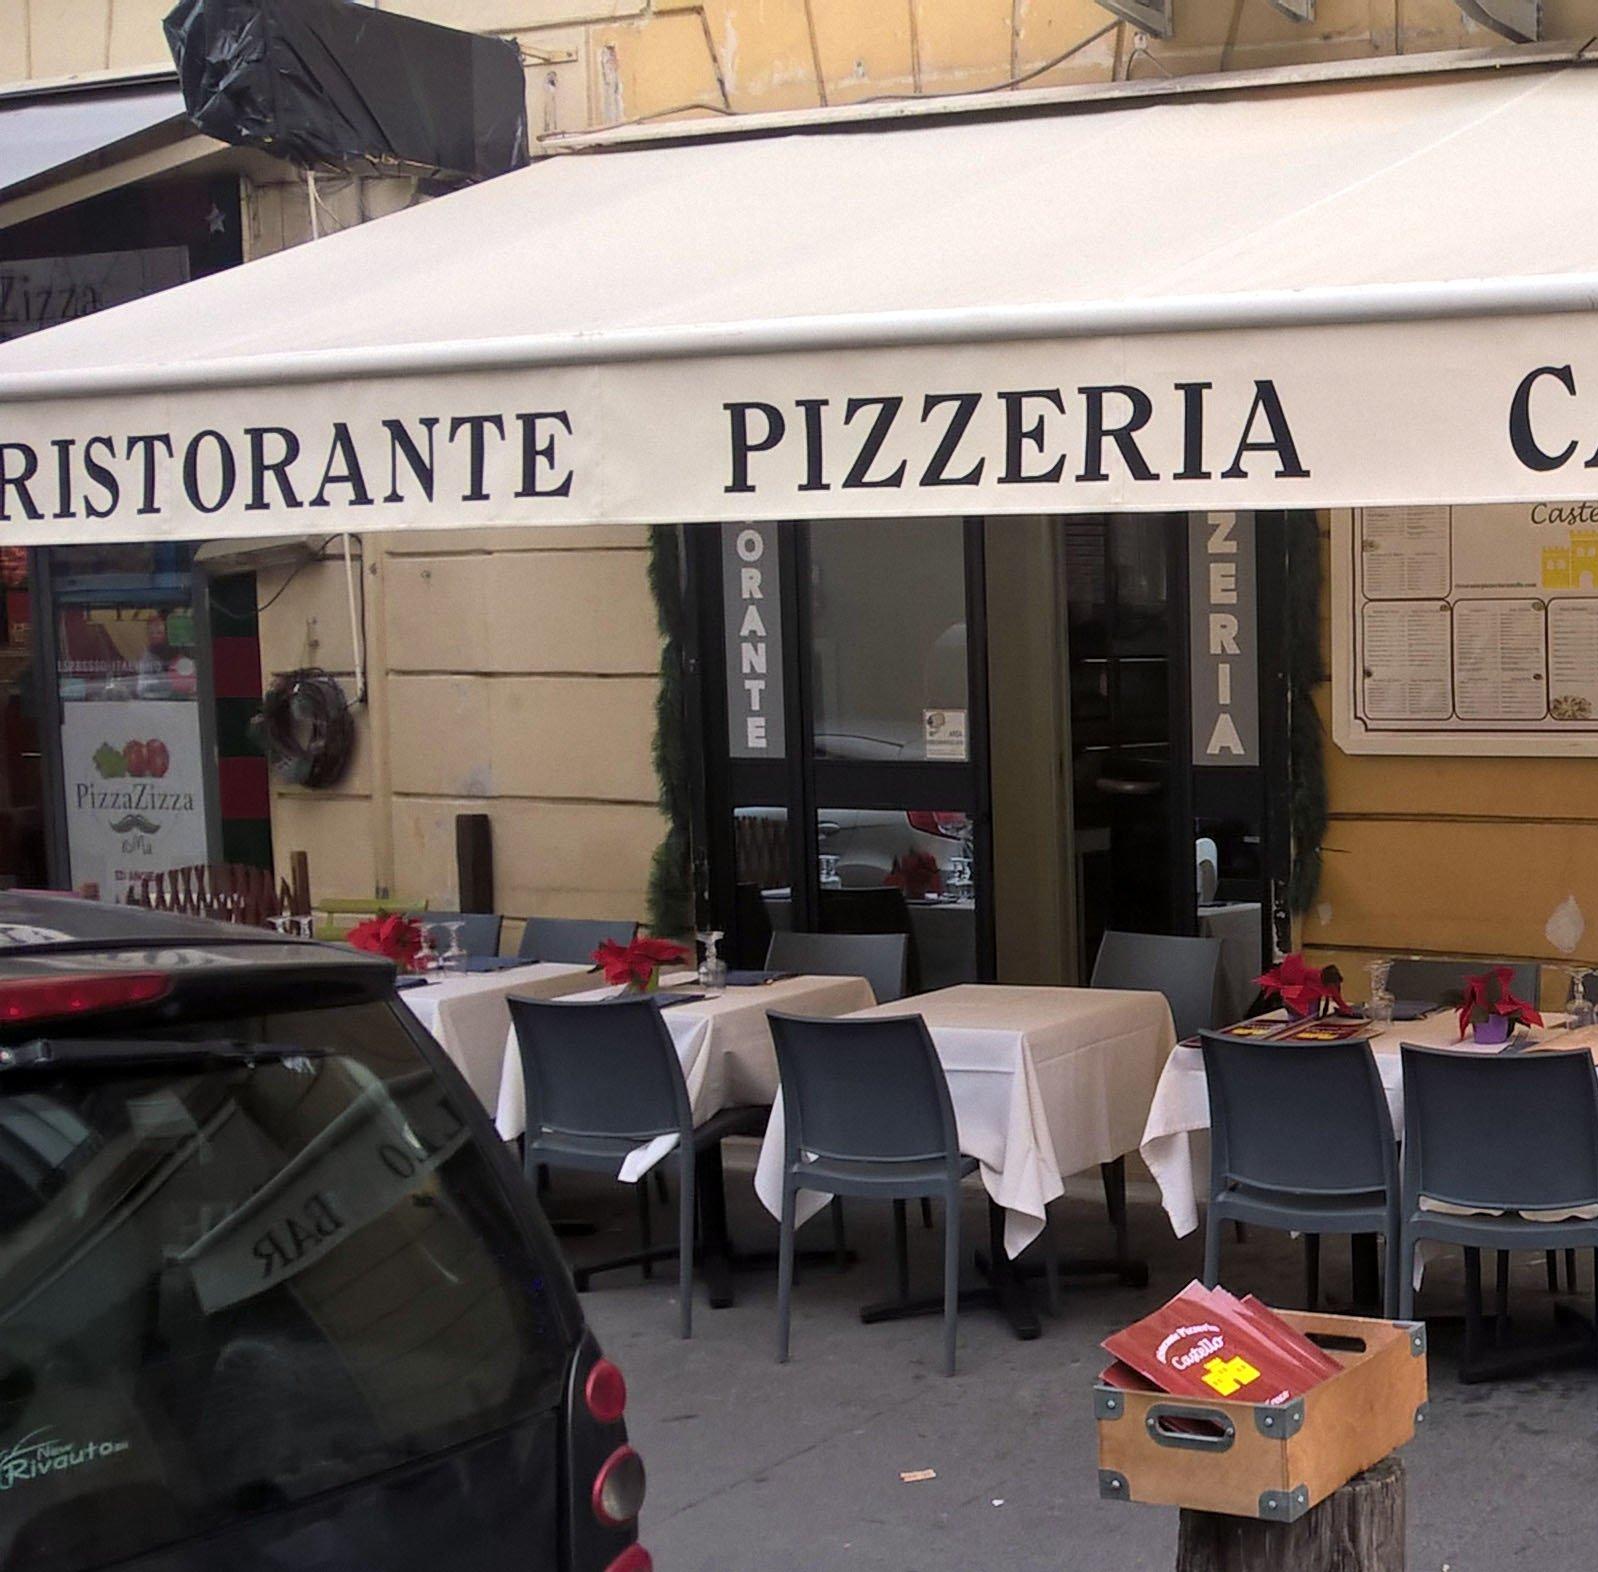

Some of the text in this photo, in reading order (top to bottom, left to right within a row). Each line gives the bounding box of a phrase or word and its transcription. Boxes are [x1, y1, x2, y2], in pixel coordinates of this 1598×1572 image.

[0, 410, 574, 521] RISTORANTE
[722, 379, 1311, 494] PIZZERIA
[1205, 511, 1246, 756] ZERIA
[75, 783, 194, 811] PizzaZizza
